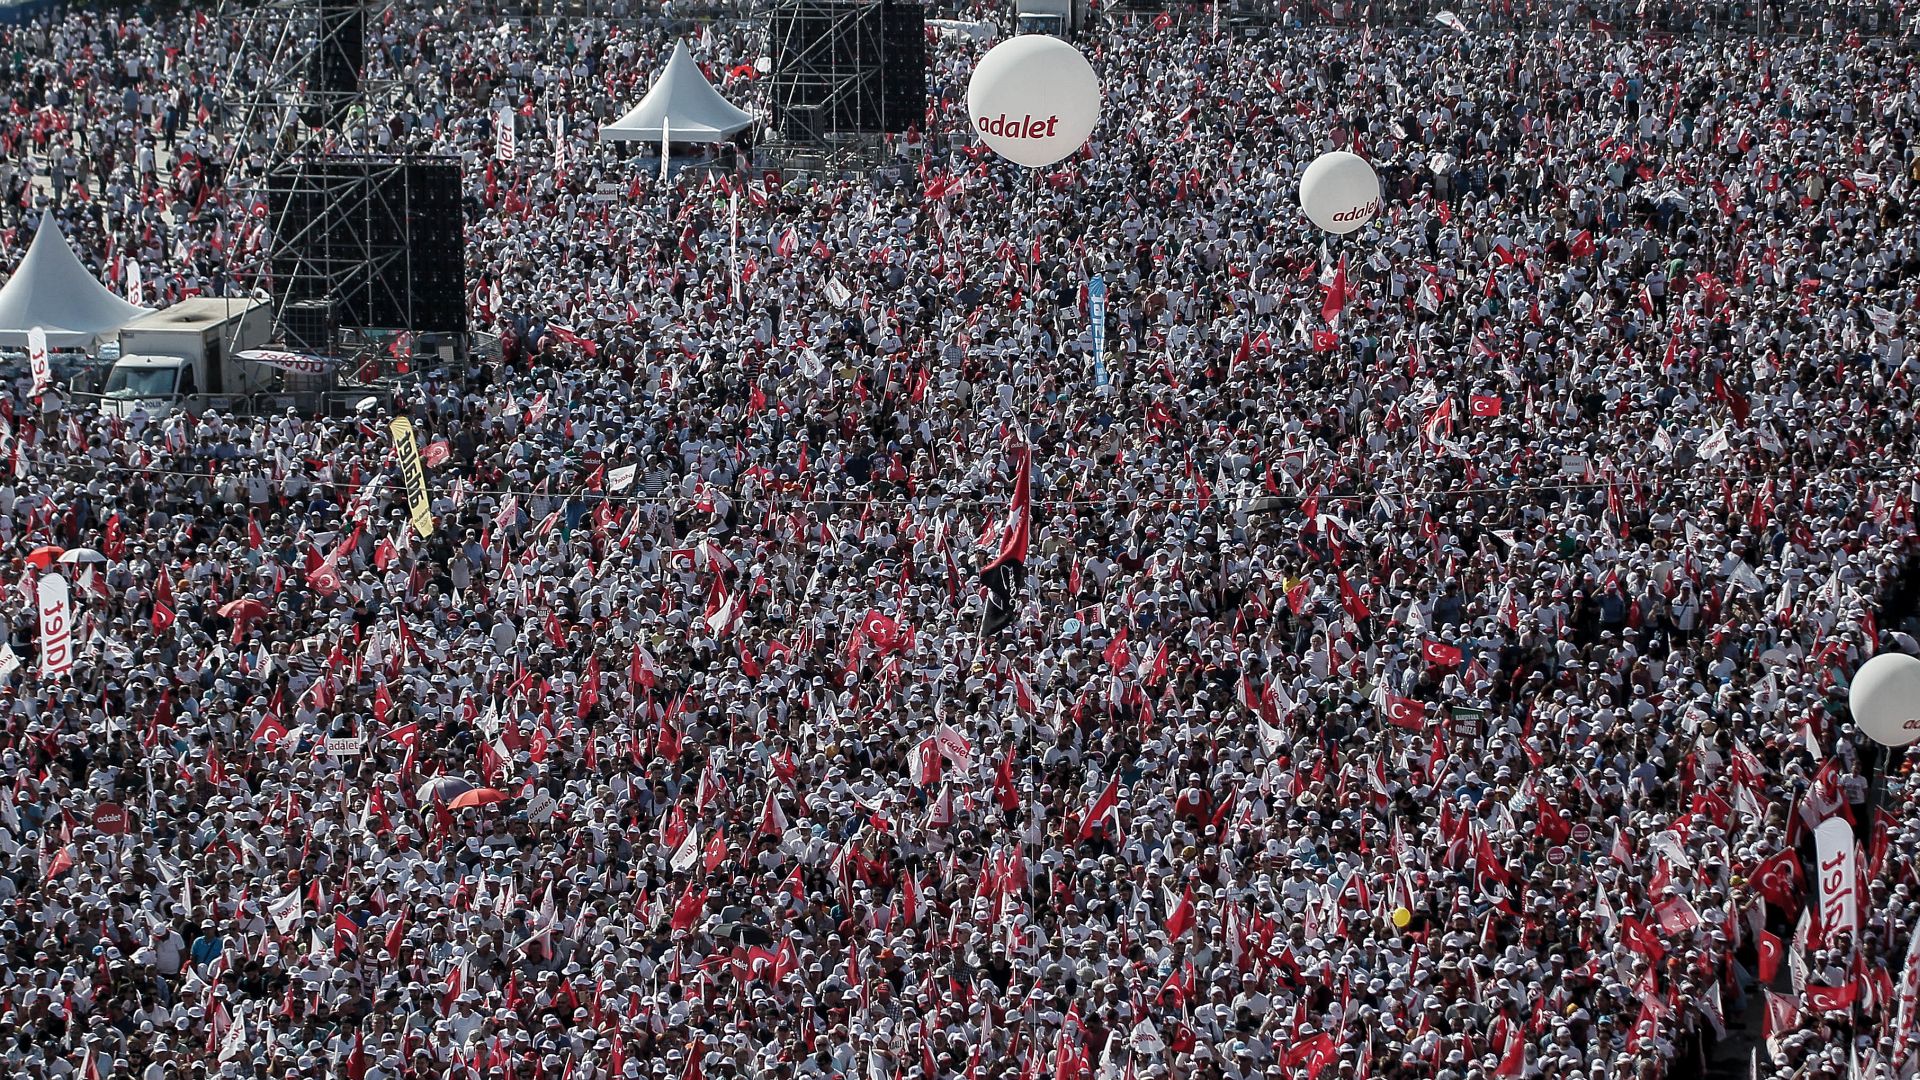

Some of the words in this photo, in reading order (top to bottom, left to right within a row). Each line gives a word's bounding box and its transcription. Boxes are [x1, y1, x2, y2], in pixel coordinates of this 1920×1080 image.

[978, 113, 1058, 139] adalet
[1455, 725, 1477, 736] OMUZA
[327, 740, 359, 752] adalet
[940, 737, 969, 759] adalet
[529, 798, 552, 819] adalet
[97, 814, 121, 823] adalet
